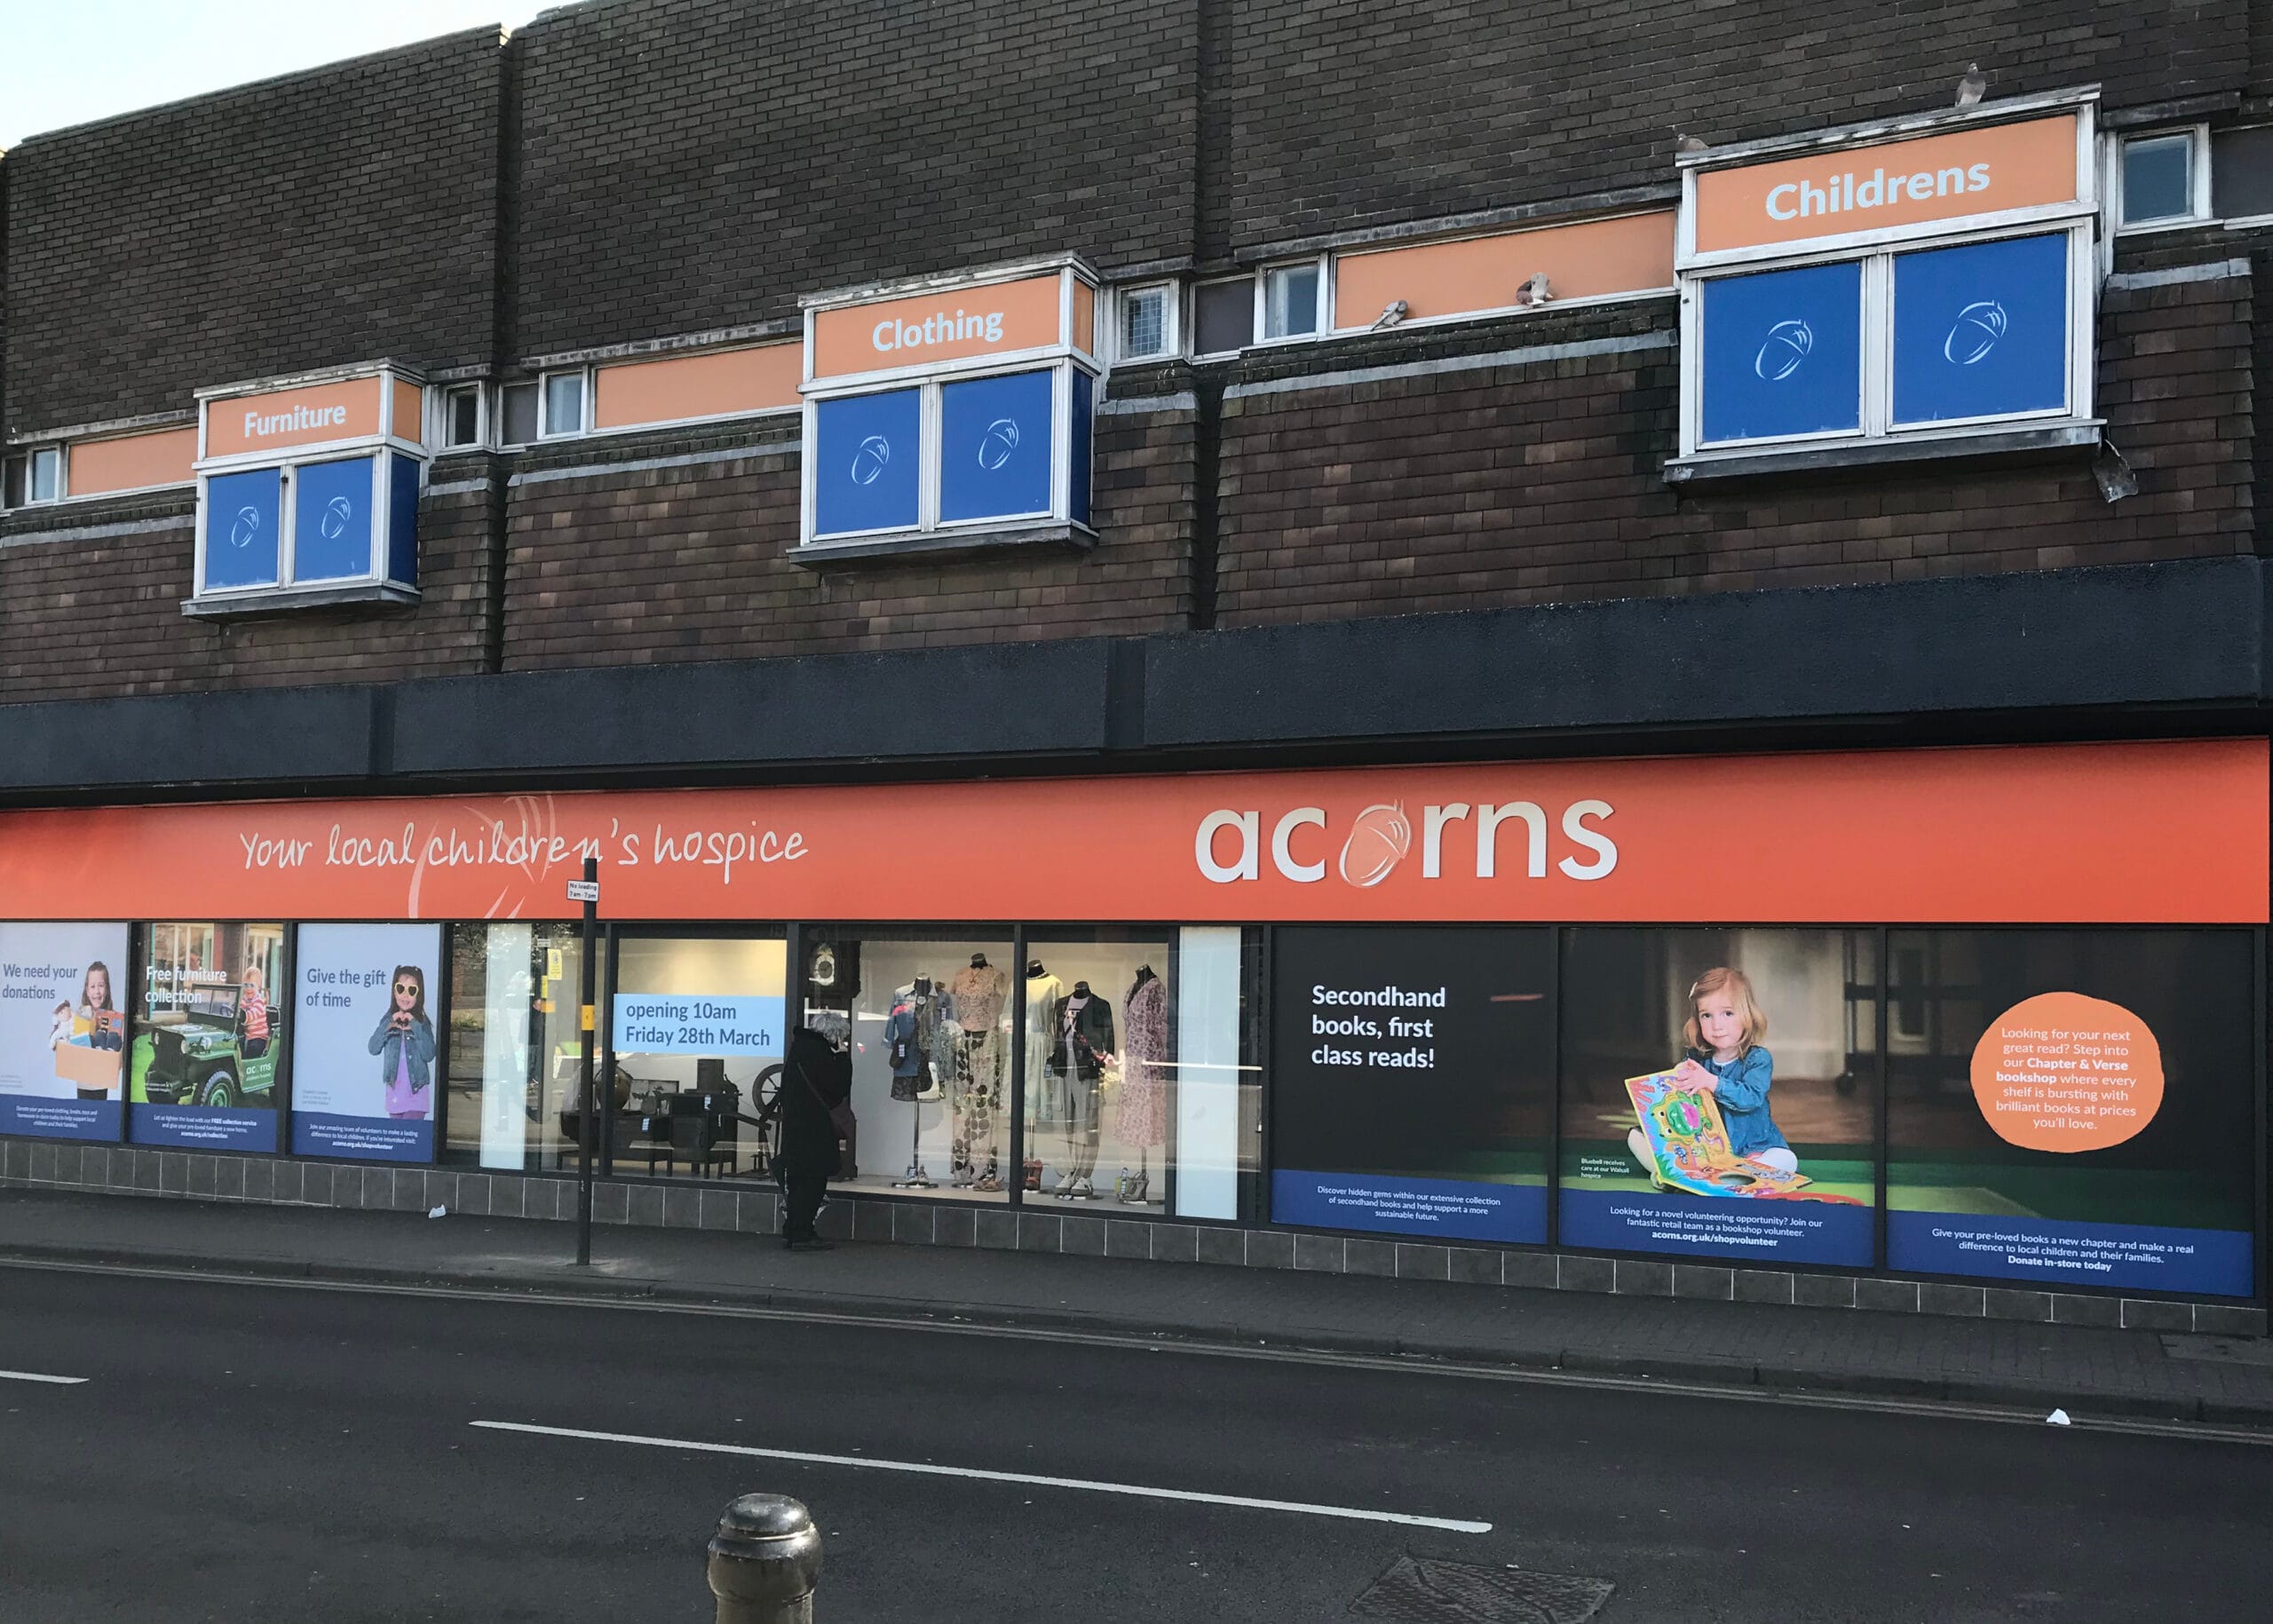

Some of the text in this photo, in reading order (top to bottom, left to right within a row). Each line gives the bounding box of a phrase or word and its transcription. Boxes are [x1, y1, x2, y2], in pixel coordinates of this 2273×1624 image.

[1765, 162, 1990, 220] Childrens
[873, 309, 1003, 351] Clothing
[244, 405, 345, 438] Furniture
[326, 822, 416, 866] local
[428, 818, 641, 867] children's
[653, 820, 810, 884] hospice
[4, 964, 77, 980] We need your
[146, 966, 226, 982] Free furniture
[307, 969, 385, 987] Give the gift
[2, 986, 55, 999] donations
[145, 991, 202, 1003] collection
[306, 992, 351, 1007] of time
[1311, 985, 1445, 1008] Secondhand
[626, 1002, 736, 1021] opening 10am
[1311, 1014, 1433, 1040] books, first
[2002, 1027, 2131, 1041] Looking for your next
[626, 1026, 770, 1046] Friday 28th March
[1311, 1044, 1434, 1068] class reads!
[2003, 1044, 2128, 1057] great read? Step into
[2027, 1058, 2077, 1070] Chapter
[2079, 1059, 2088, 1069] &
[2093, 1059, 2128, 1070] Verse
[1996, 1072, 2136, 1088] bookshop where every
[2003, 1087, 2128, 1101] shelf is bursting with
[1996, 1101, 2136, 1117] brilliant books at prices
[2033, 1118, 2097, 1129] you'll love.
[1380, 1200, 1401, 1208] books
[1417, 1202, 1432, 1211] help
[1375, 1210, 1439, 1221] sustainable future.
[1610, 1207, 1640, 1217] Looking
[1684, 1212, 1734, 1223] volunteering
[1736, 1216, 1788, 1226] opportunity?
[1627, 1218, 1659, 1227] fantastic
[1723, 1224, 1762, 1235] bookshop
[1763, 1227, 1804, 1237] volunteer.
[1651, 1232, 1778, 1246] acorns.org.uk/shopvolunteer
[1932, 1228, 1952, 1237] Give
[1953, 1232, 1975, 1242] your
[1976, 1232, 2019, 1241] pre-loved
[2021, 1234, 2049, 1243] books
[2081, 1239, 2117, 1248] chapter
[1959, 1241, 2003, 1251] difference
[2017, 1245, 2039, 1254] local
[2041, 1247, 2078, 1256] children
[2100, 1251, 2123, 1260] their
[2125, 1252, 2164, 1263] families.
[2008, 1256, 2111, 1271] Donate in-store today
